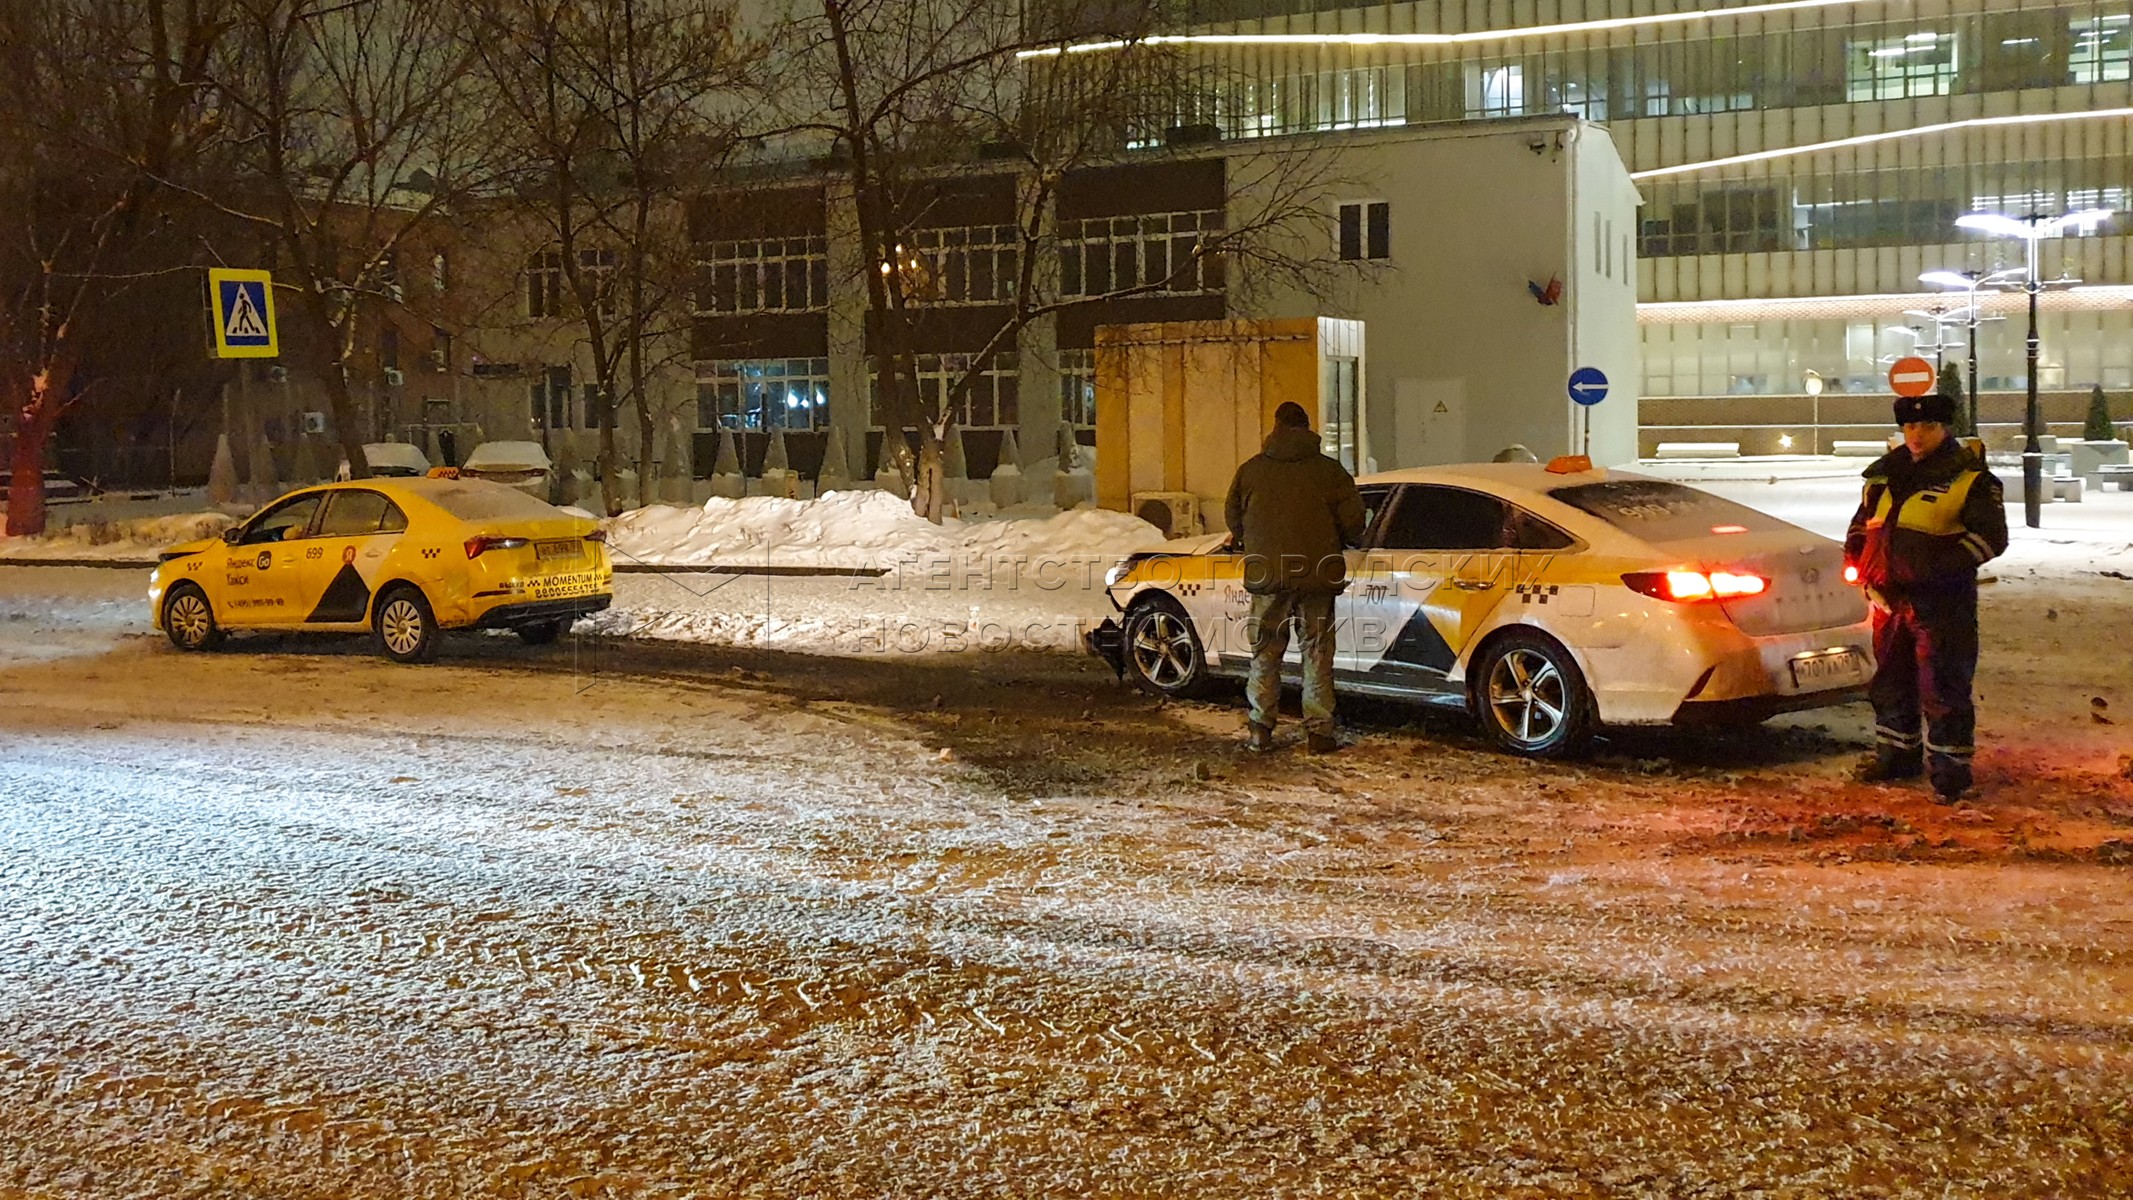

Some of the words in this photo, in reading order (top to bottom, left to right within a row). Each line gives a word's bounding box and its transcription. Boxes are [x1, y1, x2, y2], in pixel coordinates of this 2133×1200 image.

[306, 547, 324, 559] 699
[543, 574, 592, 587] MOMENTUM
[1224, 585, 1250, 606] Янде
[1366, 585, 1388, 605] 707
